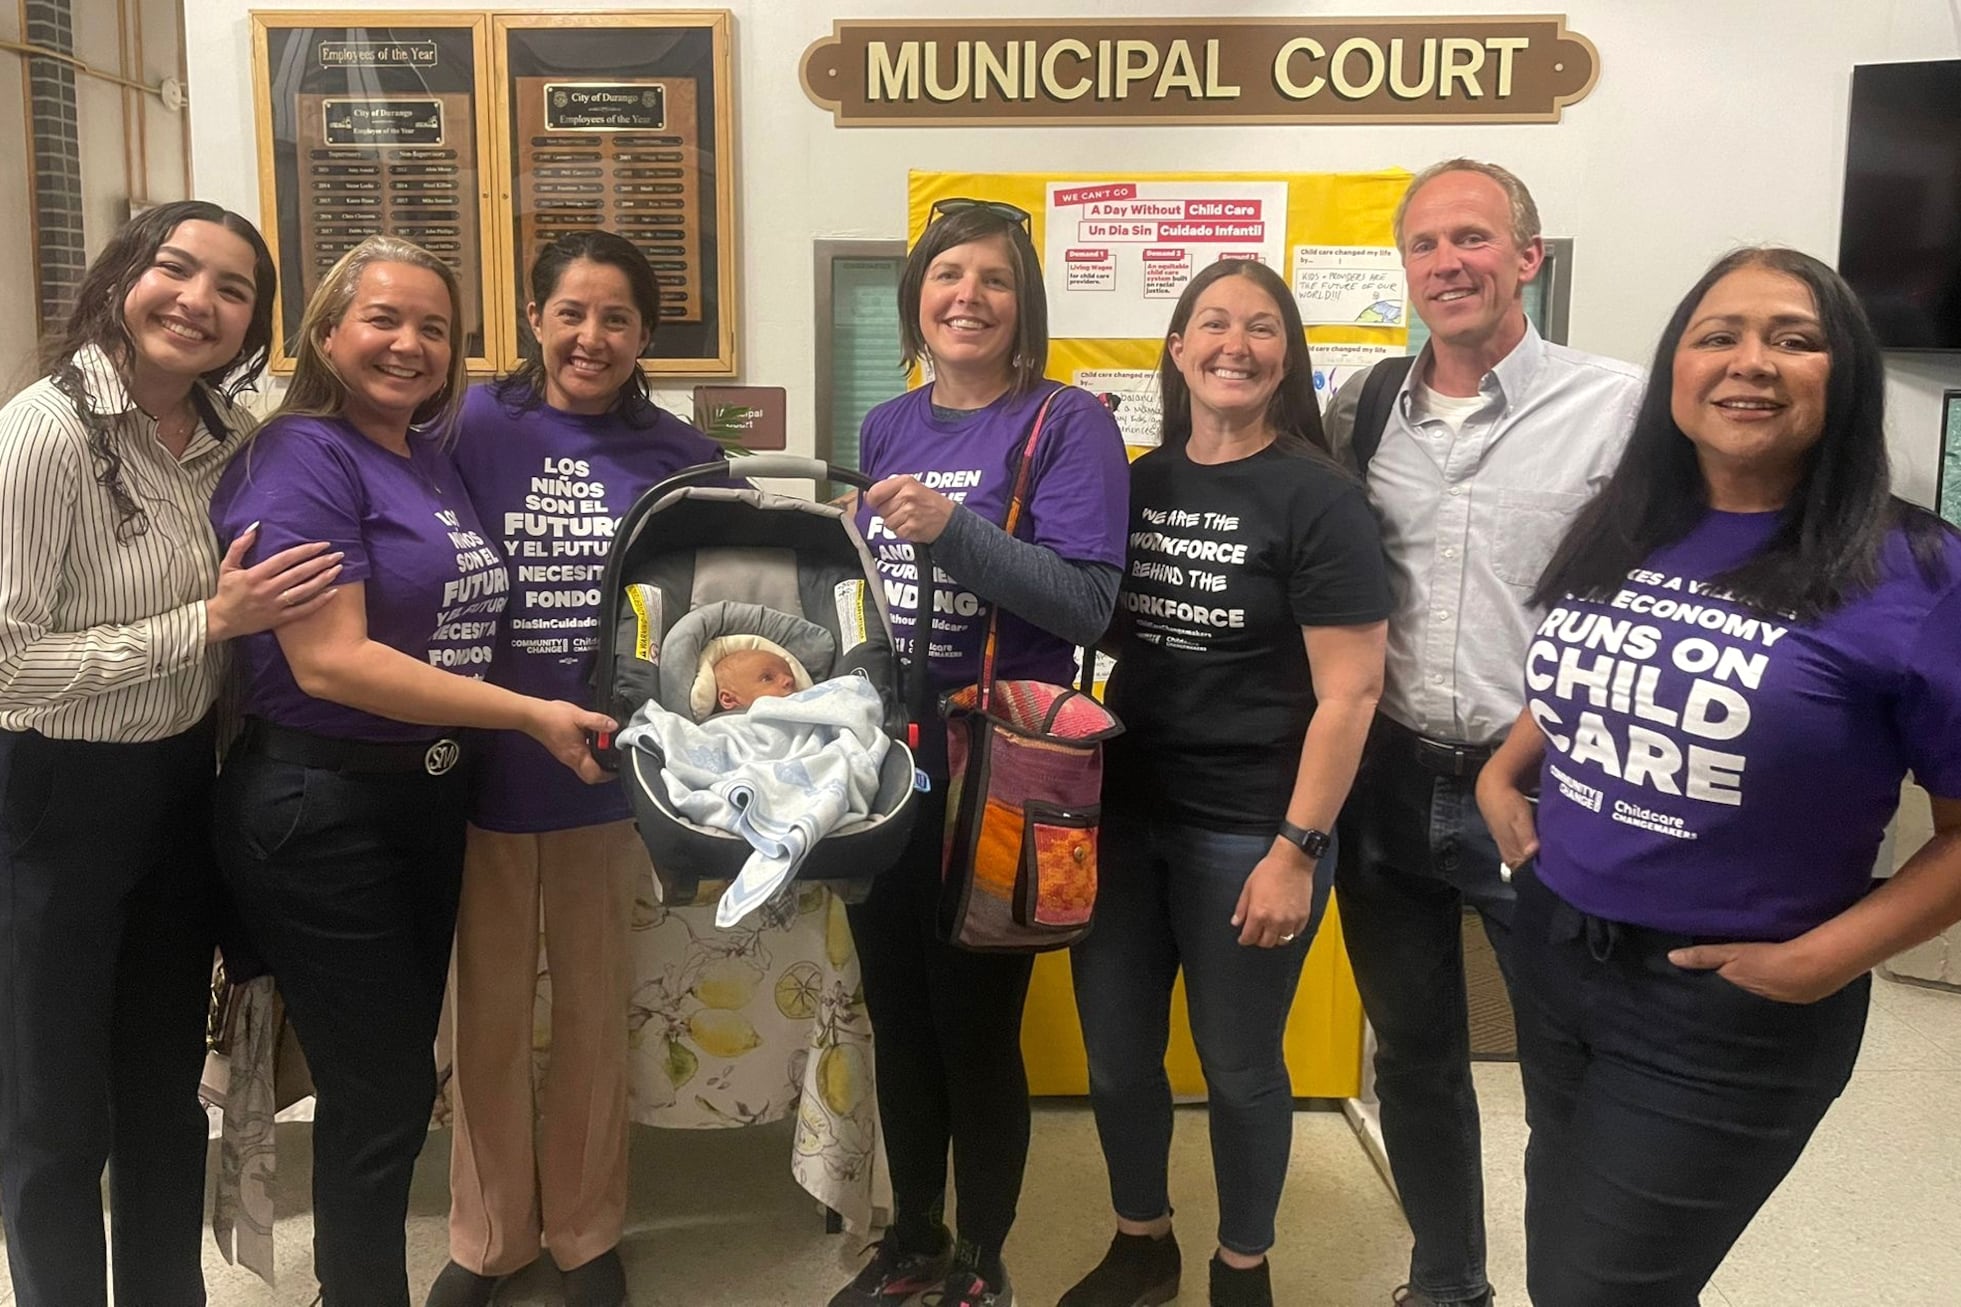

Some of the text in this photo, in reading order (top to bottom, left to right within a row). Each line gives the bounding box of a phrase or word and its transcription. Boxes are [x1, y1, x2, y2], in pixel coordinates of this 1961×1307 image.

[322, 47, 434, 63] Employees of the Year
[865, 37, 1529, 102] MUNICIPAL COURT
[571, 92, 639, 104] City of Durango
[353, 109, 413, 118] City of Durango
[559, 114, 651, 125] Employees of the Year
[1062, 188, 1129, 202] WE CAN'T GO
[1091, 204, 1255, 217] A Day Without Child Care
[1089, 225, 1262, 236] Un Dia Sin Cuidado Infantil
[1069, 250, 1098, 258] Demand
[1302, 272, 1320, 280] KIDS
[1329, 272, 1365, 281] PROVIDERS
[1369, 272, 1388, 281] ARE
[1299, 282, 1318, 290] THE
[1321, 282, 1358, 291] FUTURE
[1377, 283, 1397, 292] OUR
[1331, 345, 1361, 353] changed
[544, 457, 590, 478] LOS
[531, 475, 605, 499] NIÑOS
[525, 495, 608, 514] SON EL
[1142, 508, 1240, 532] WE ARE THE
[504, 541, 612, 557] Y EL FUTU
[879, 543, 915, 561] AND
[1129, 532, 1248, 565] WORKFORCE
[456, 547, 500, 573] SON EL
[518, 565, 605, 582] NECESIT
[1131, 560, 1227, 592] BEHIND THE
[1662, 577, 1683, 591] A
[525, 589, 601, 608] FONDO
[436, 612, 449, 628] Y
[1610, 589, 1788, 647] ECONOMY
[526, 645, 563, 654] CHANGE
[1536, 607, 1769, 690] RUNS ON
[1525, 640, 1751, 741] CHILD
[1528, 698, 1746, 806] CARE
[1614, 799, 1684, 829] Childcare
[1612, 812, 1698, 840] CHANGEMAKERS
